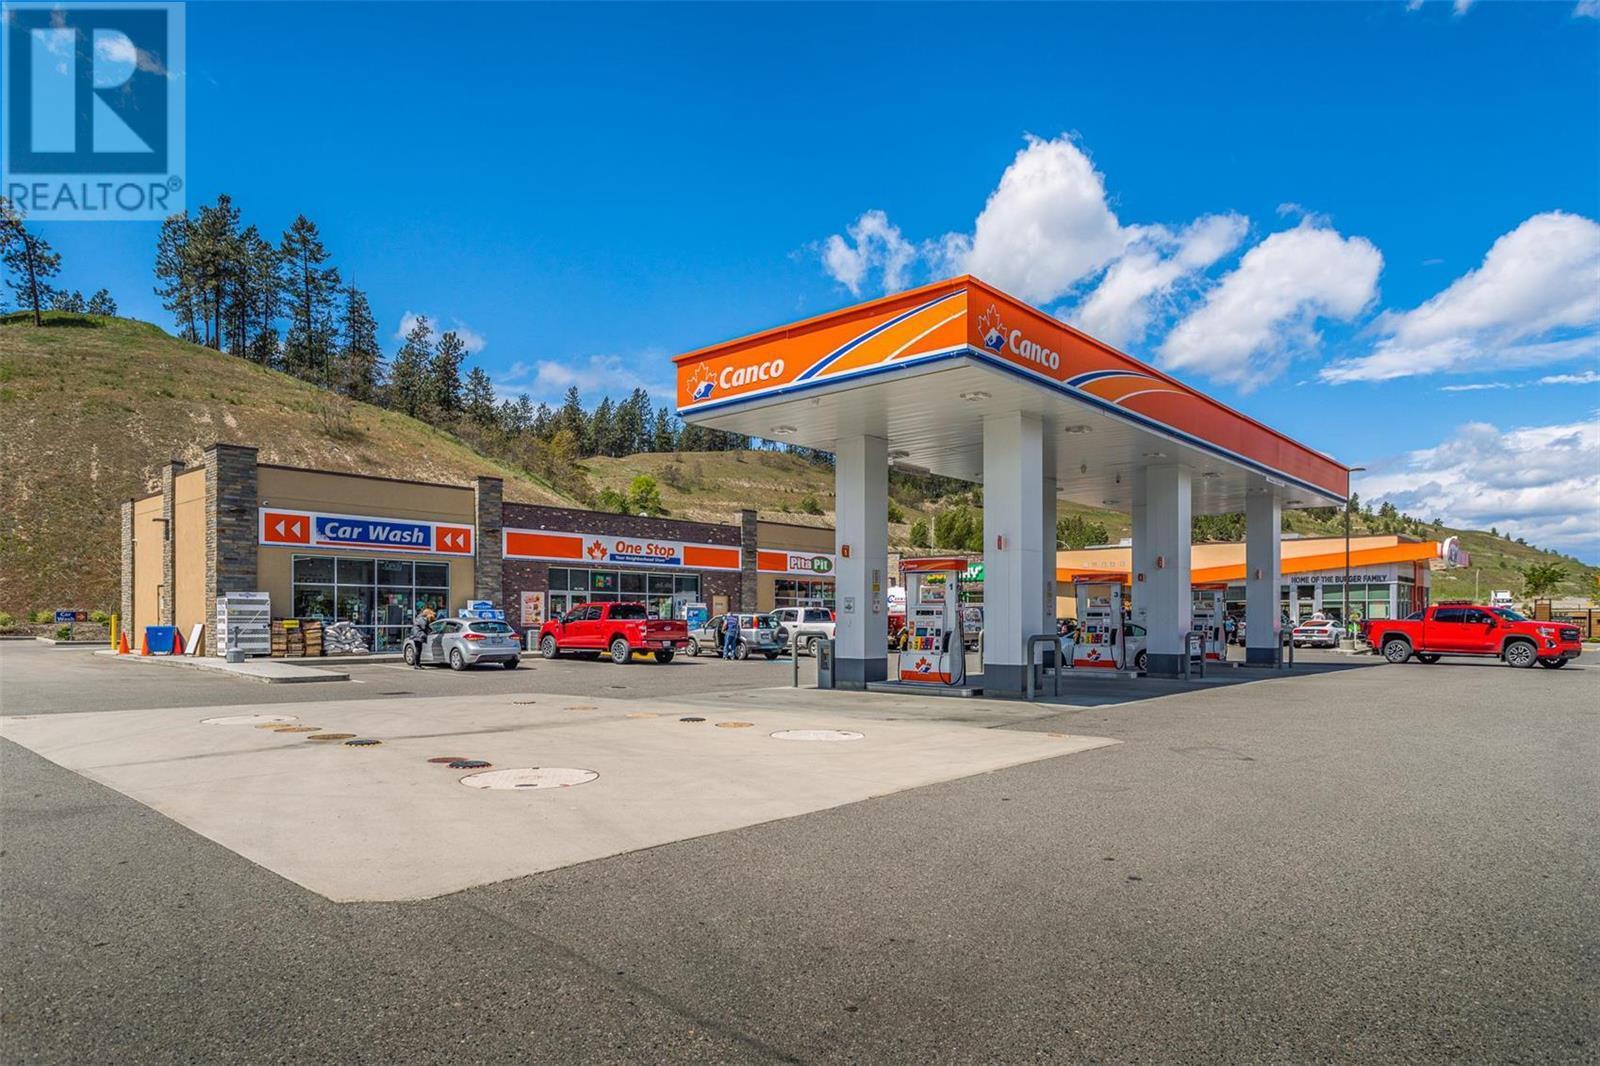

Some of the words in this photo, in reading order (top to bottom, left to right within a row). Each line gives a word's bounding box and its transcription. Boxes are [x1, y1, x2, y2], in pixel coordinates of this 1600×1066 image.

[1008, 329, 1060, 370] Canco
[720, 358, 785, 389] Canco
[324, 521, 362, 539] Car
[368, 525, 425, 544] Wash
[616, 541, 642, 554] One
[646, 543, 675, 558] Stop
[790, 556, 812, 570] Pita
[813, 556, 829, 570] Pit
[1291, 575, 1309, 584] HOME
[1311, 575, 1320, 583] OF
[1321, 575, 1332, 583] THE
[1363, 575, 1387, 583] FAMILY
